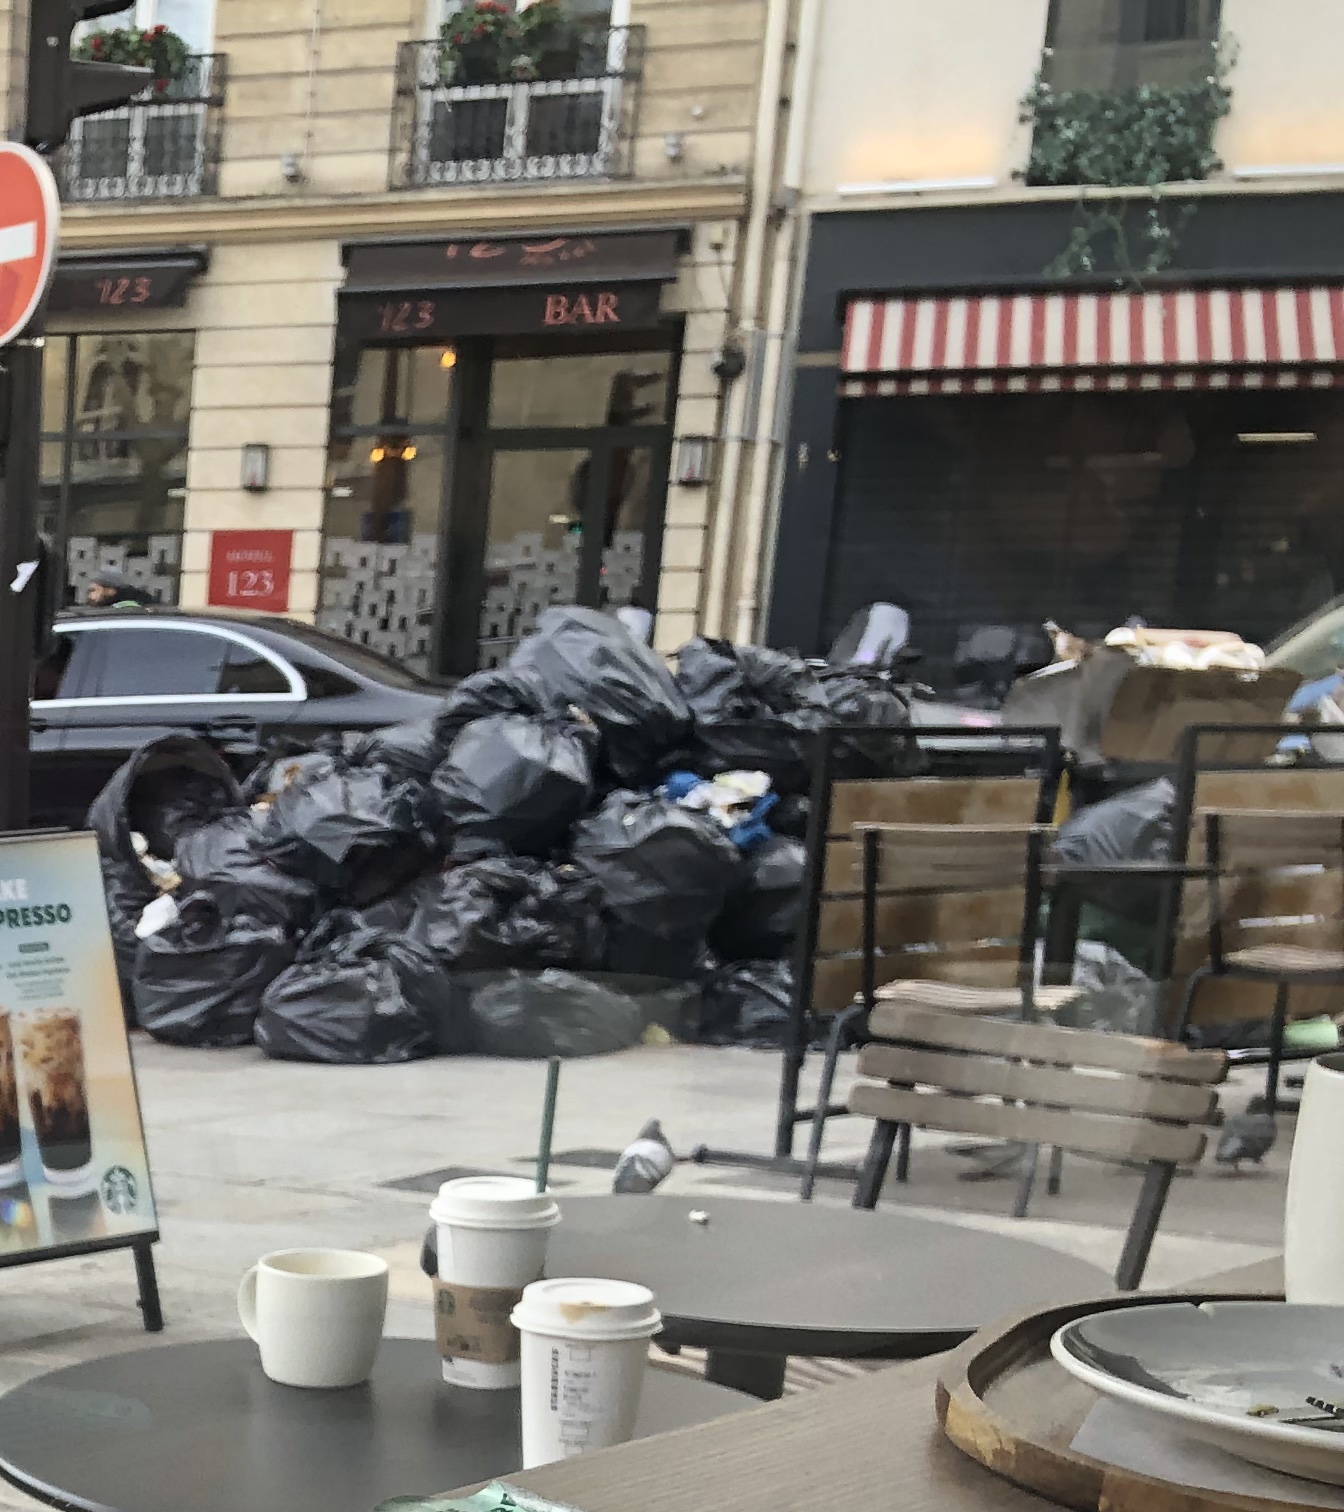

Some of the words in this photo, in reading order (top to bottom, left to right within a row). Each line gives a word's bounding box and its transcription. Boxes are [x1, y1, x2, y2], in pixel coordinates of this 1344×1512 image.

[95, 276, 152, 305] 123
[378, 300, 435, 331] 123
[543, 291, 620, 327] BAR
[227, 570, 275, 597] 123
